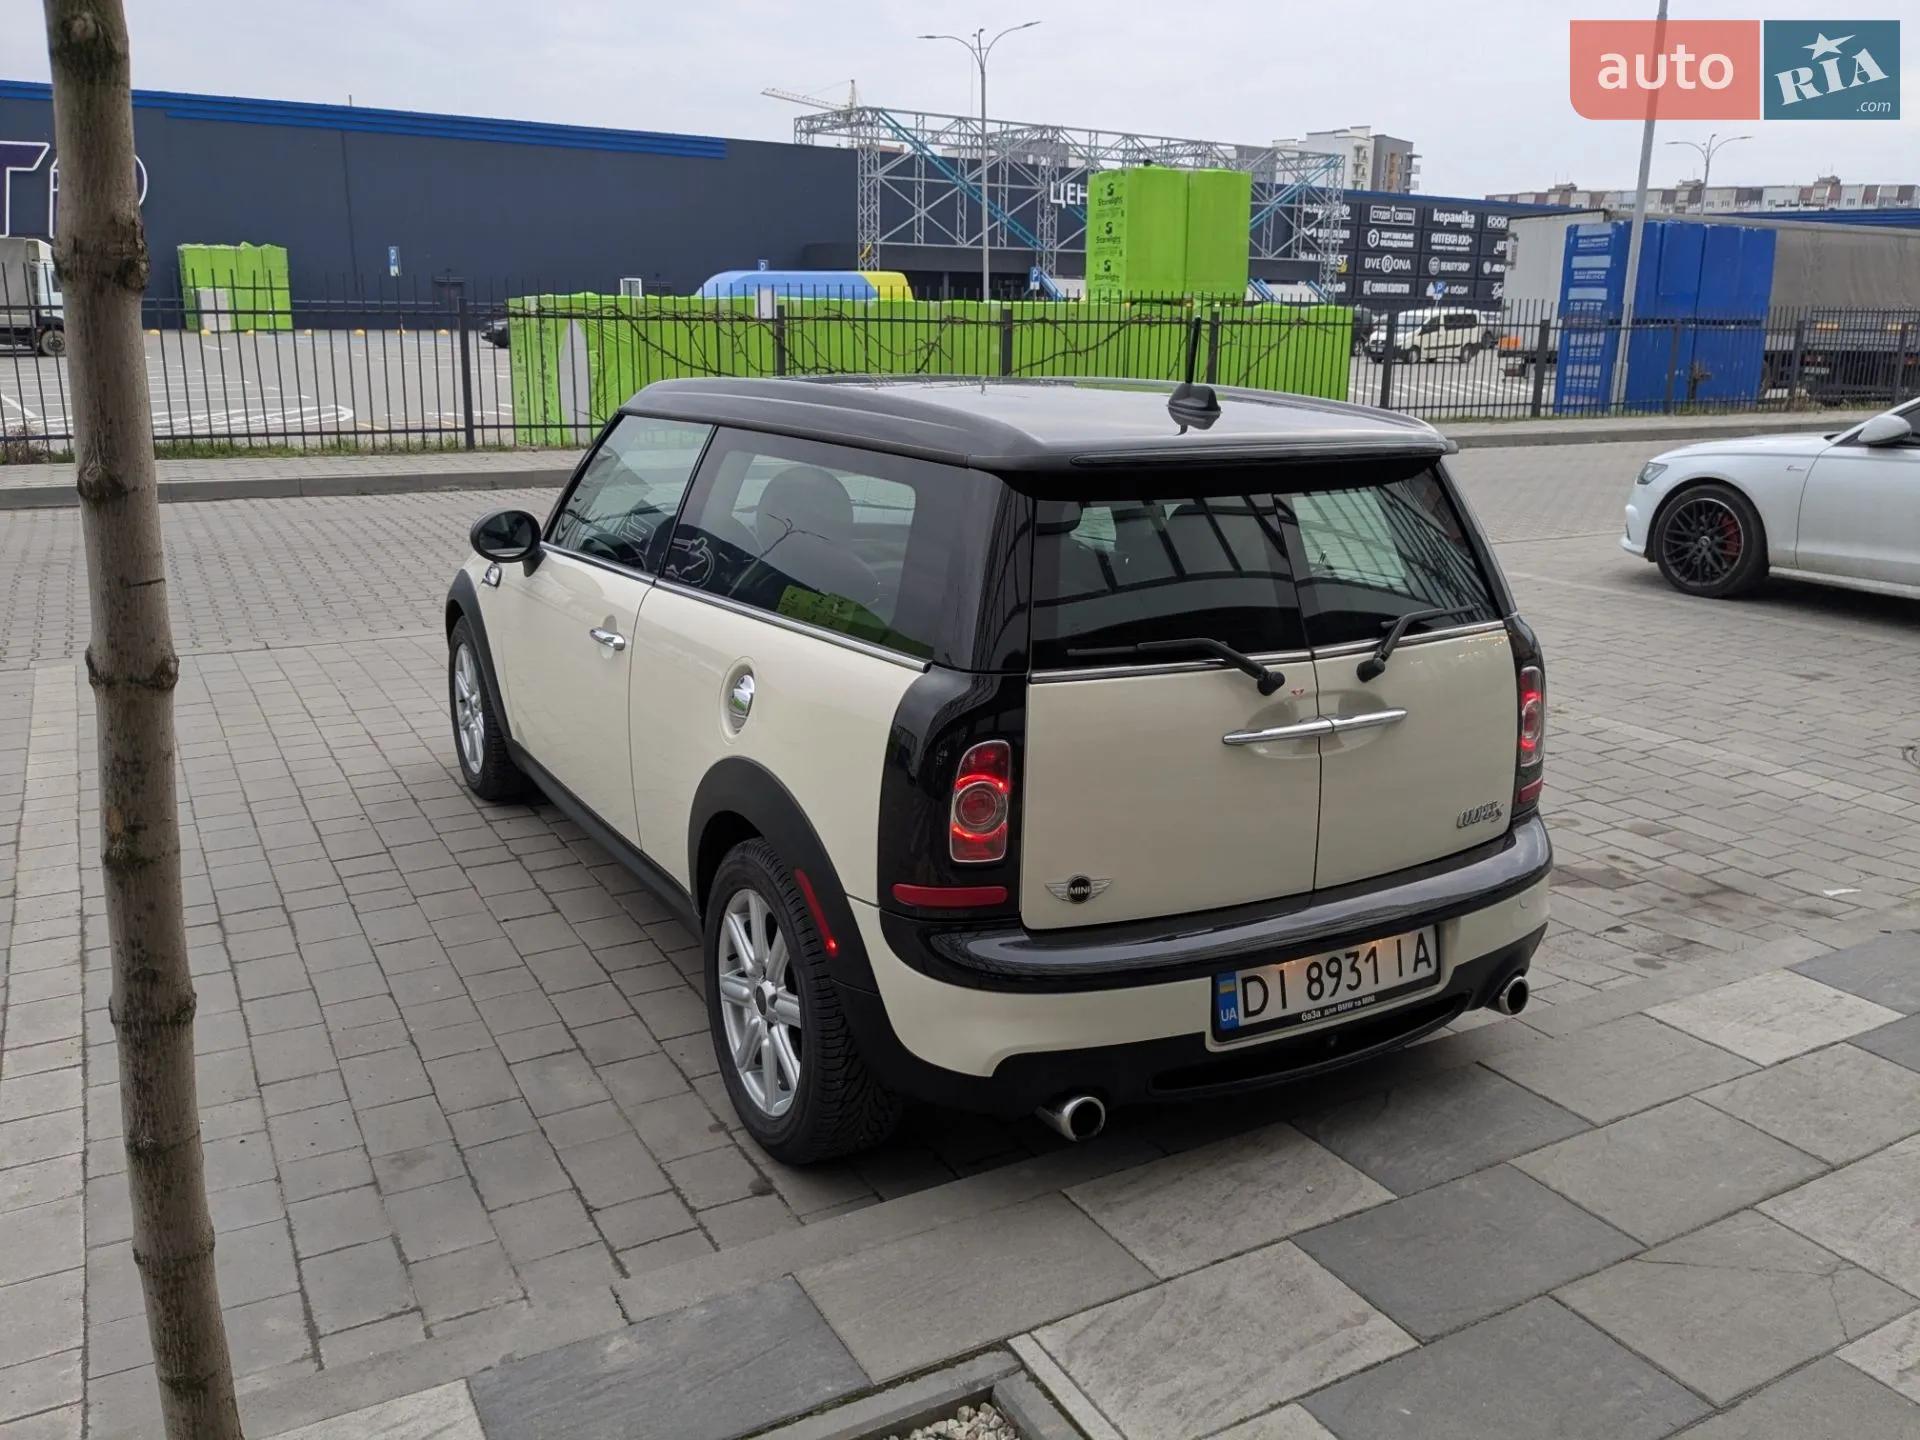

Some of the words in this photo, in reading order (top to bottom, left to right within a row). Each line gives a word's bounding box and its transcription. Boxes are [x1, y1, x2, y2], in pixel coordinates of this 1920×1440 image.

[1069, 885, 1091, 896] MINI
[1241, 969, 1288, 1018] DI
[1306, 946, 1380, 1001] 8931
[1396, 931, 1432, 977] IA
[1221, 1009, 1238, 1022] UA
